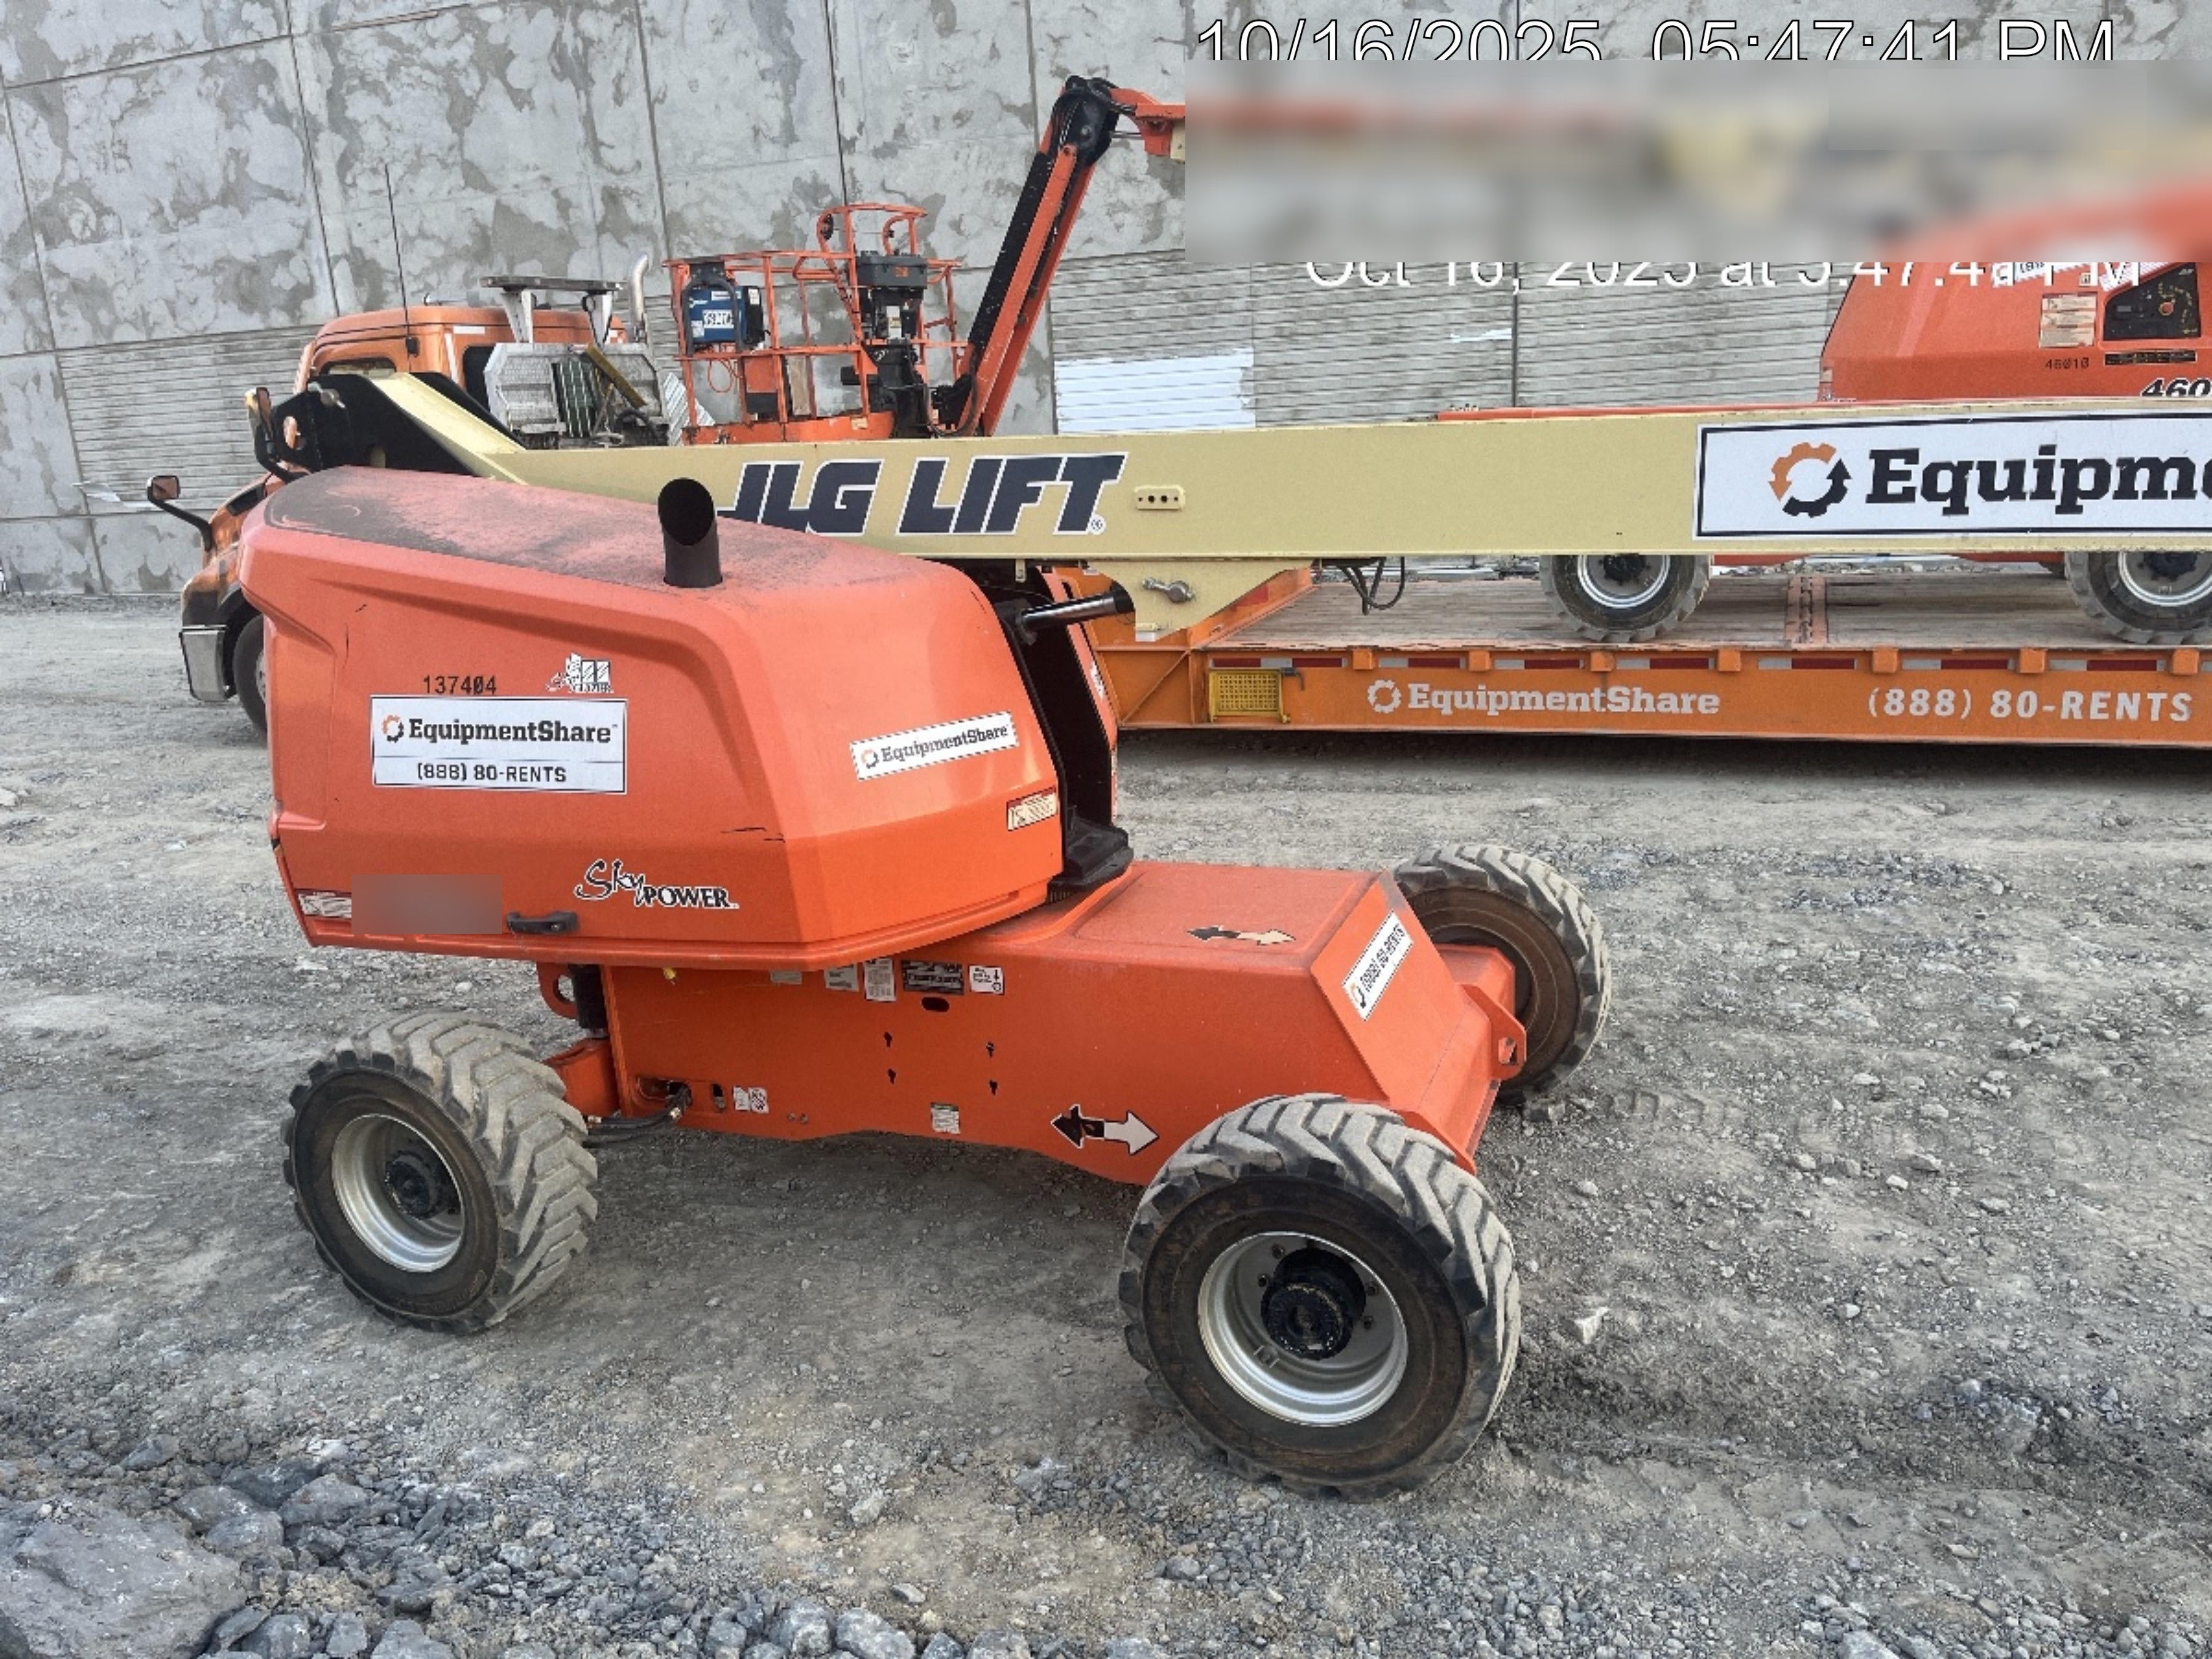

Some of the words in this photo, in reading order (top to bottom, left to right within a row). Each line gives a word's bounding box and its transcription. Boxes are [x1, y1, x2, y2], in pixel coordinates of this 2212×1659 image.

[716, 459, 884, 535] JLG
[895, 452, 1129, 535] LIFT
[1866, 444, 2212, 516] Equipm
[1408, 683, 1720, 715] EquipmentShare
[1868, 688, 1971, 718] (888)
[1990, 689, 2192, 722] 80-RENTS
[409, 718, 611, 745] EquipmentShare
[880, 724, 1009, 762] EquipmentShare
[417, 763, 468, 782] (888)
[473, 764, 567, 783] 80-RENTS
